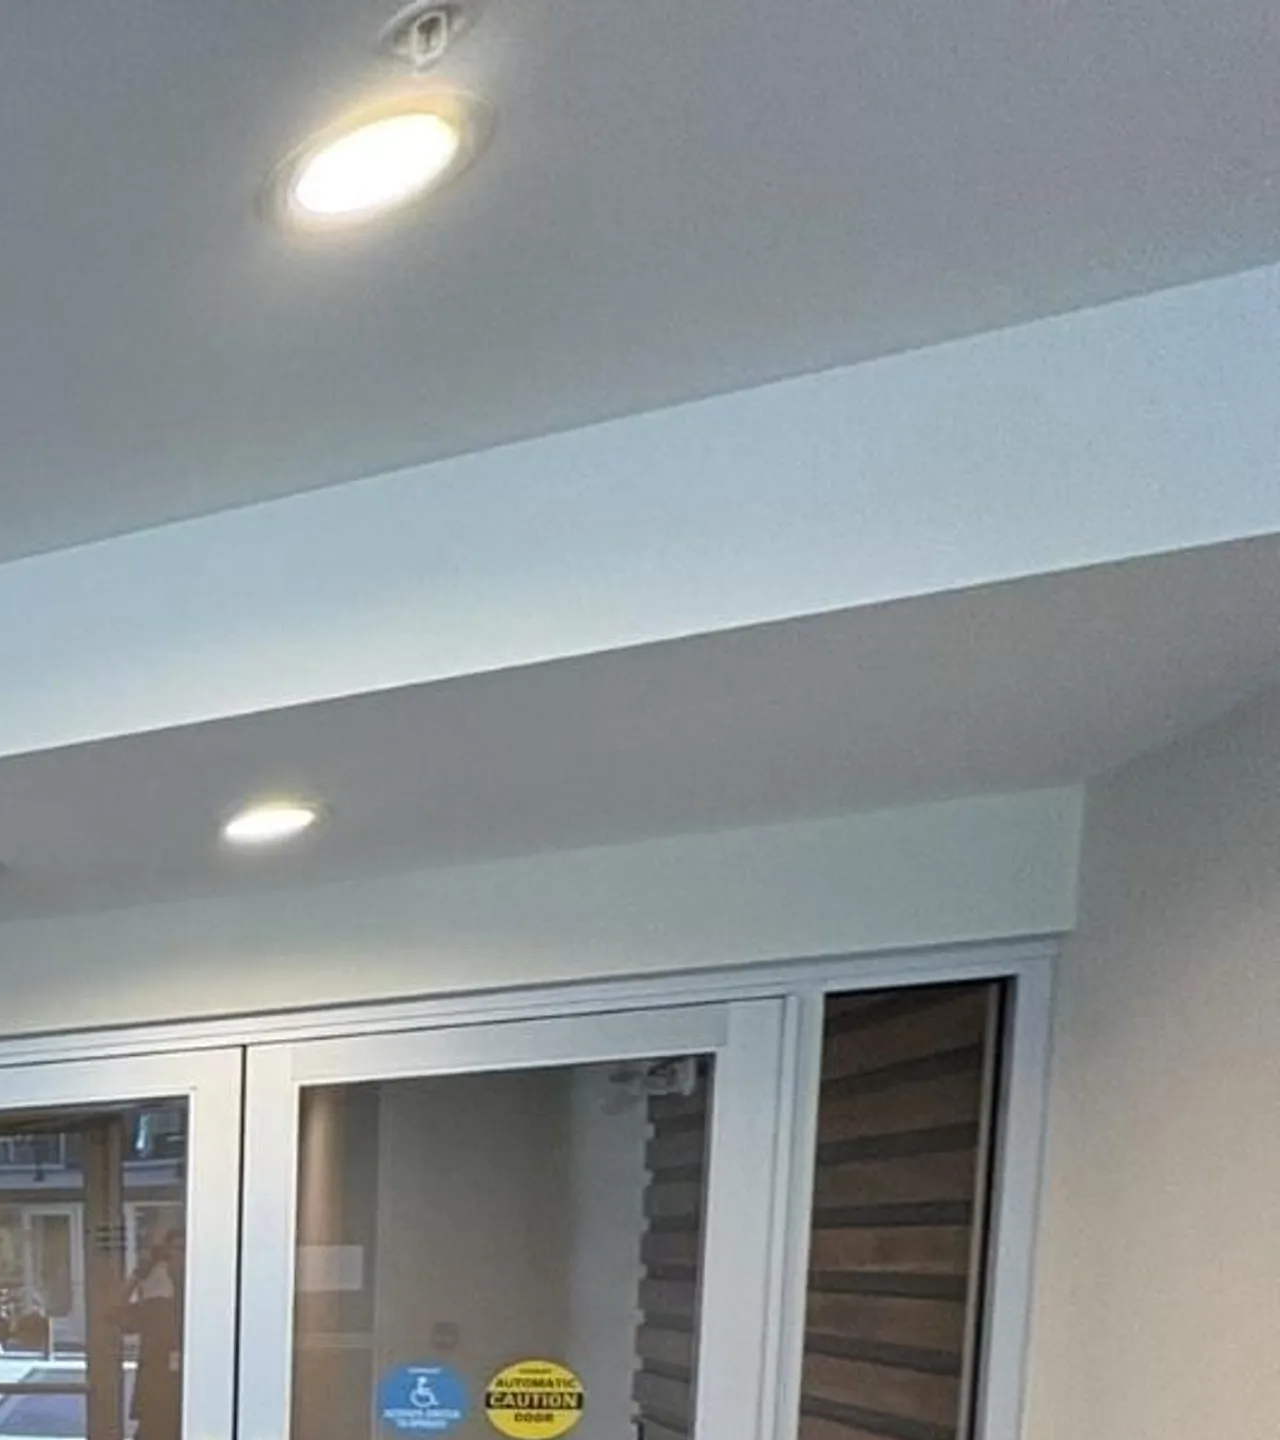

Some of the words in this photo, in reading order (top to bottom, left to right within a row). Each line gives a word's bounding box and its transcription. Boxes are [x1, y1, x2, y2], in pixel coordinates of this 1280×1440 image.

[495, 1378, 577, 1389] AUTOMATIC
[490, 1393, 578, 1407] CAUTION
[514, 1413, 554, 1423] DOOR
